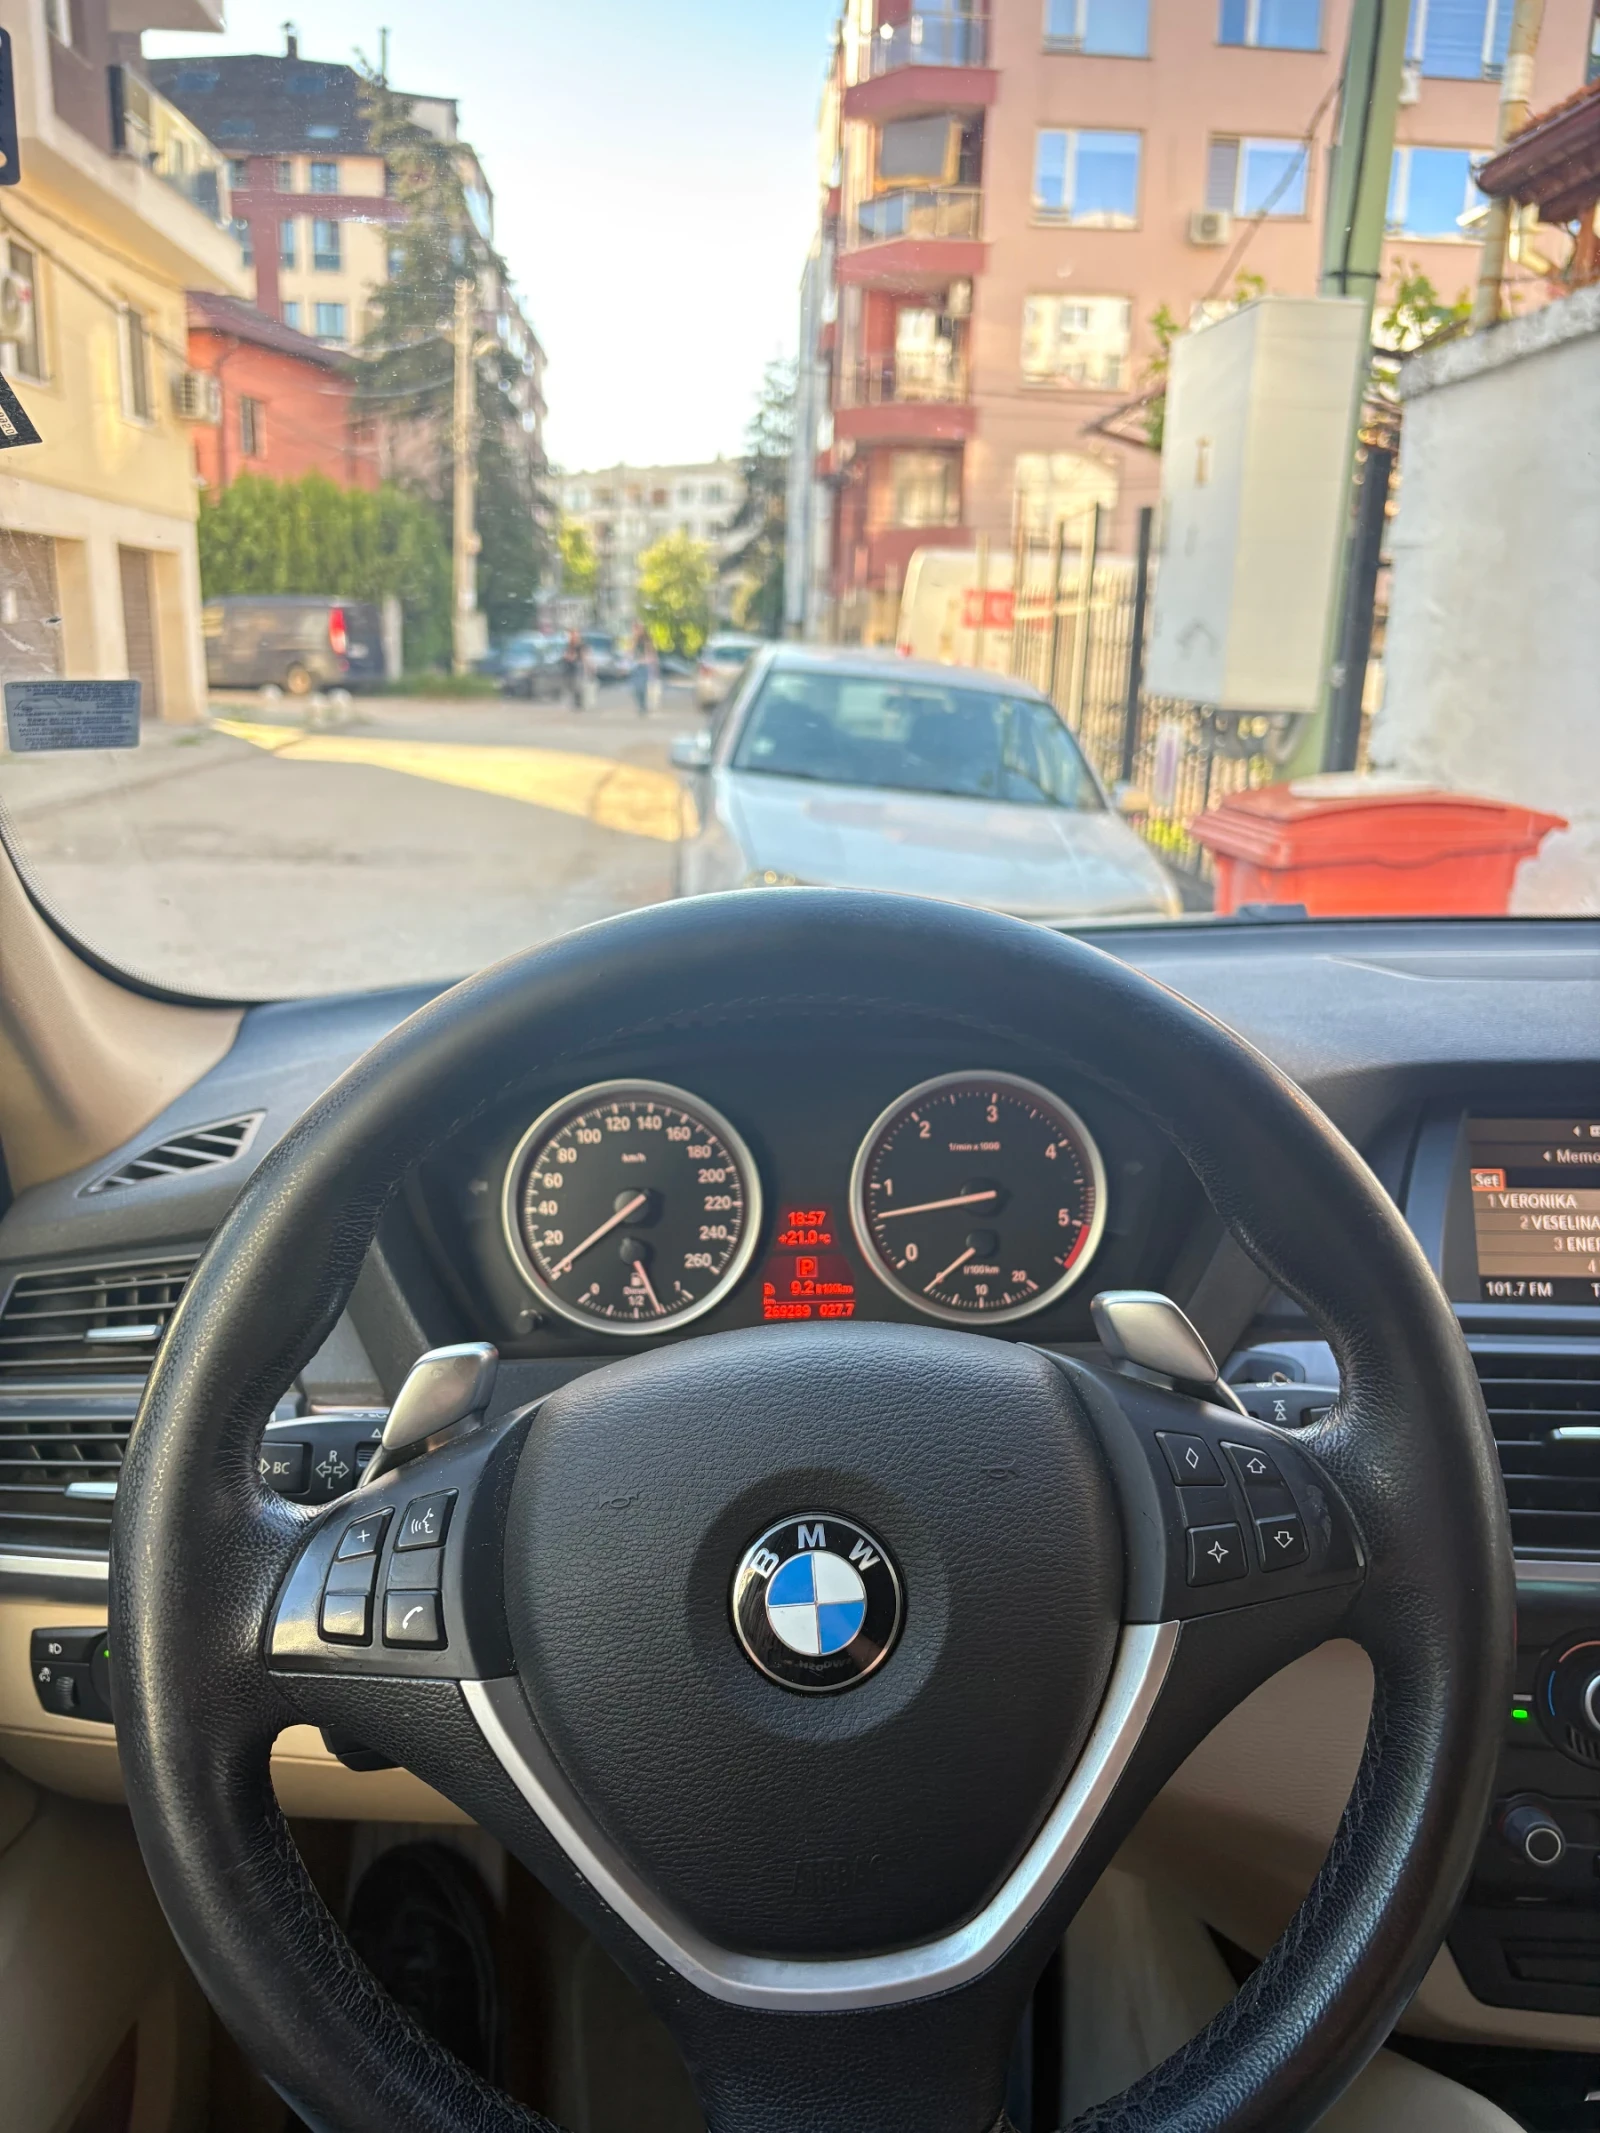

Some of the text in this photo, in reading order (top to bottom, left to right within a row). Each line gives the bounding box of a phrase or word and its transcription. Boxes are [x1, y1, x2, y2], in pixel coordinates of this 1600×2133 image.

[986, 1105, 998, 1122] 3
[605, 1116, 630, 1131] 120
[637, 1116, 662, 1130] 140
[919, 1121, 931, 1138] 2
[576, 1128, 601, 1144] 100
[666, 1127, 691, 1141] 160
[557, 1147, 577, 1163] 80
[622, 1152, 646, 1163] km/h
[687, 1144, 711, 1158] 180
[1045, 1144, 1057, 1160] 4
[543, 1172, 563, 1187] 60
[698, 1168, 725, 1183] 200
[1475, 1173, 1499, 1187] Set
[884, 1178, 892, 1196] 1
[538, 1200, 558, 1216] 40
[704, 1196, 731, 1210] 220
[1488, 1193, 1577, 1209] 1 VERONIKA
[788, 1211, 826, 1226] 18:57
[1058, 1209, 1069, 1226] 5
[1520, 1215, 1600, 1230] 2 VESELINA
[544, 1229, 563, 1244] 20
[700, 1225, 727, 1240] 240
[1553, 1236, 1563, 1251] 3
[905, 1243, 918, 1261] 0
[684, 1252, 712, 1268] 260
[800, 1259, 814, 1275] P
[1587, 1258, 1596, 1273] 4
[1012, 1270, 1027, 1282] 20
[591, 1282, 600, 1295] 0
[674, 1280, 681, 1292] 1
[790, 1280, 815, 1295] 9.2
[976, 1283, 988, 1296] 10
[1486, 1281, 1553, 1297] 101.7 FM
[628, 1295, 644, 1307] 1/2
[329, 1450, 338, 1462] R
[273, 1461, 290, 1475] BC
[327, 1476, 334, 1489] L
[750, 1523, 880, 1579] BMW
